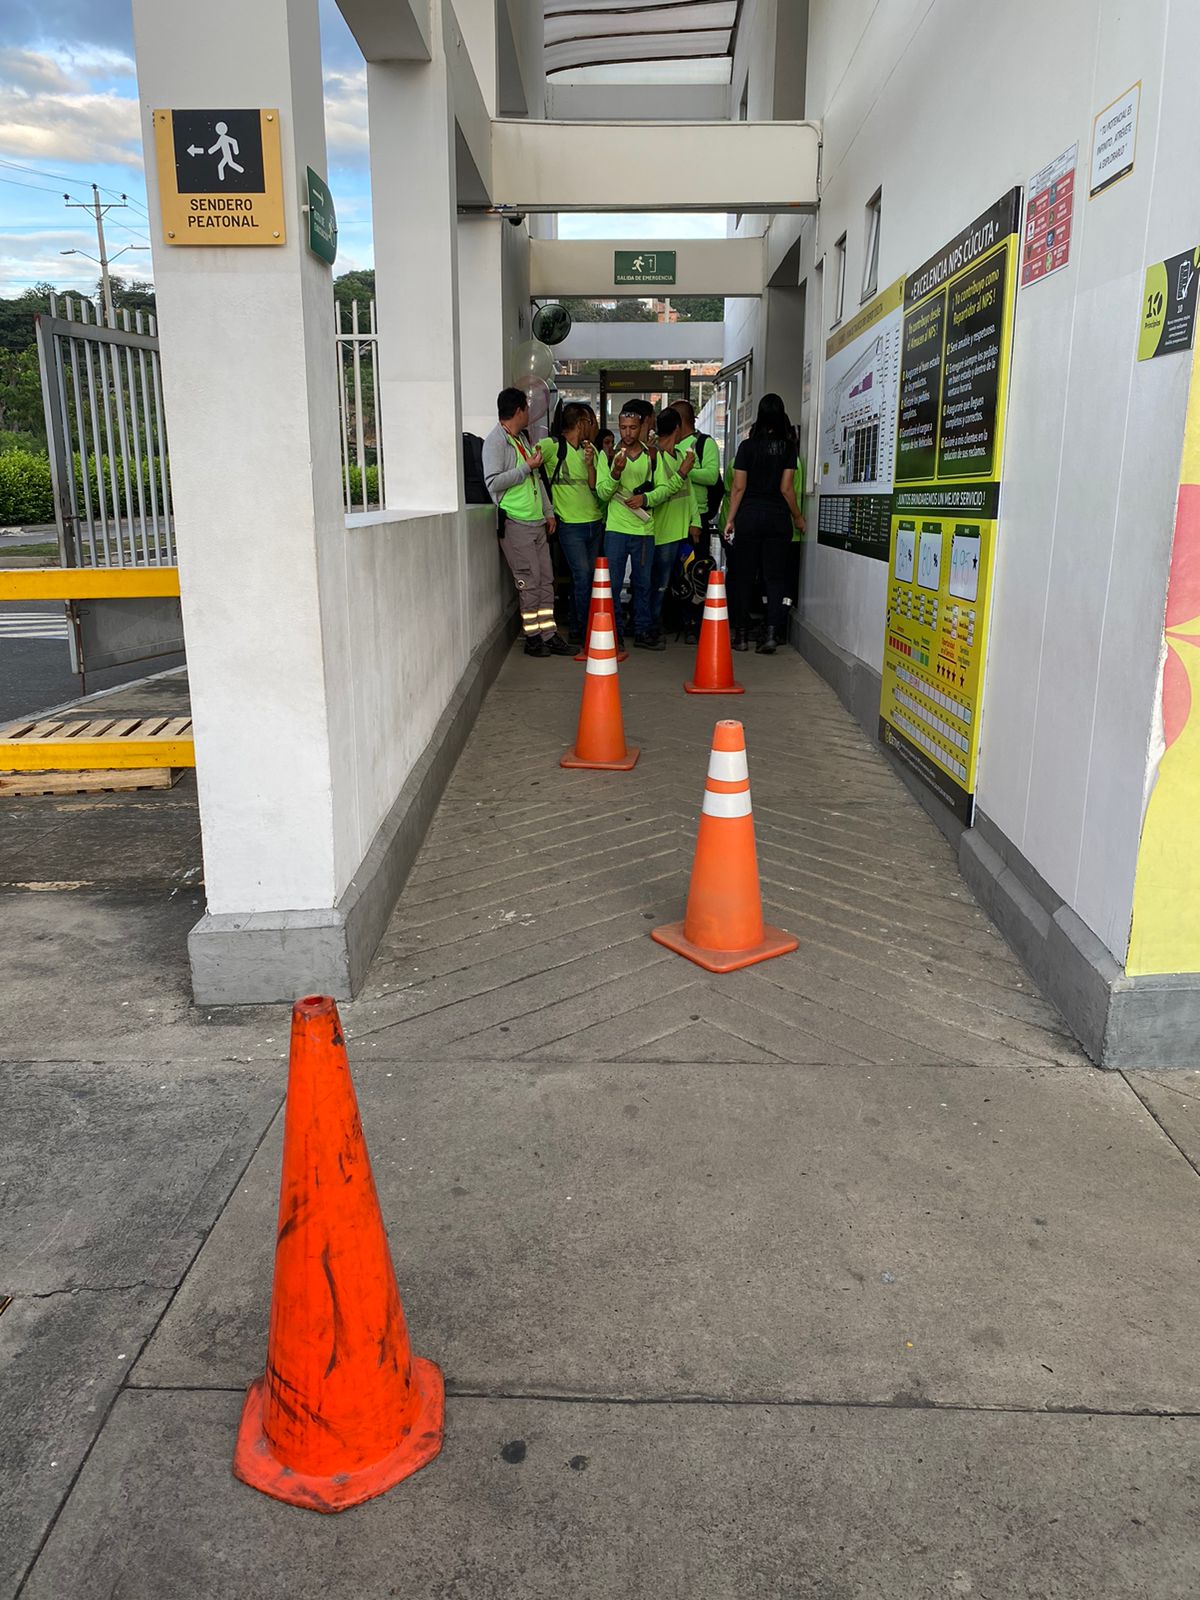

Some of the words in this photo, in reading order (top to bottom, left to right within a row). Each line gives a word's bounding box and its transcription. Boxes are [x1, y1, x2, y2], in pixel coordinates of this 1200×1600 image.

[190, 198, 252, 212] SENDERO
[188, 216, 259, 228] PEATONAL
[912, 258, 948, 300] EXCELENCIA
[948, 245, 963, 274] NPS
[963, 220, 994, 262] CÚCUTA
[960, 278, 984, 301] contribuyo
[953, 302, 975, 325] Repartidor
[1146, 291, 1163, 319] 10
[945, 492, 960, 506] MEJOR
